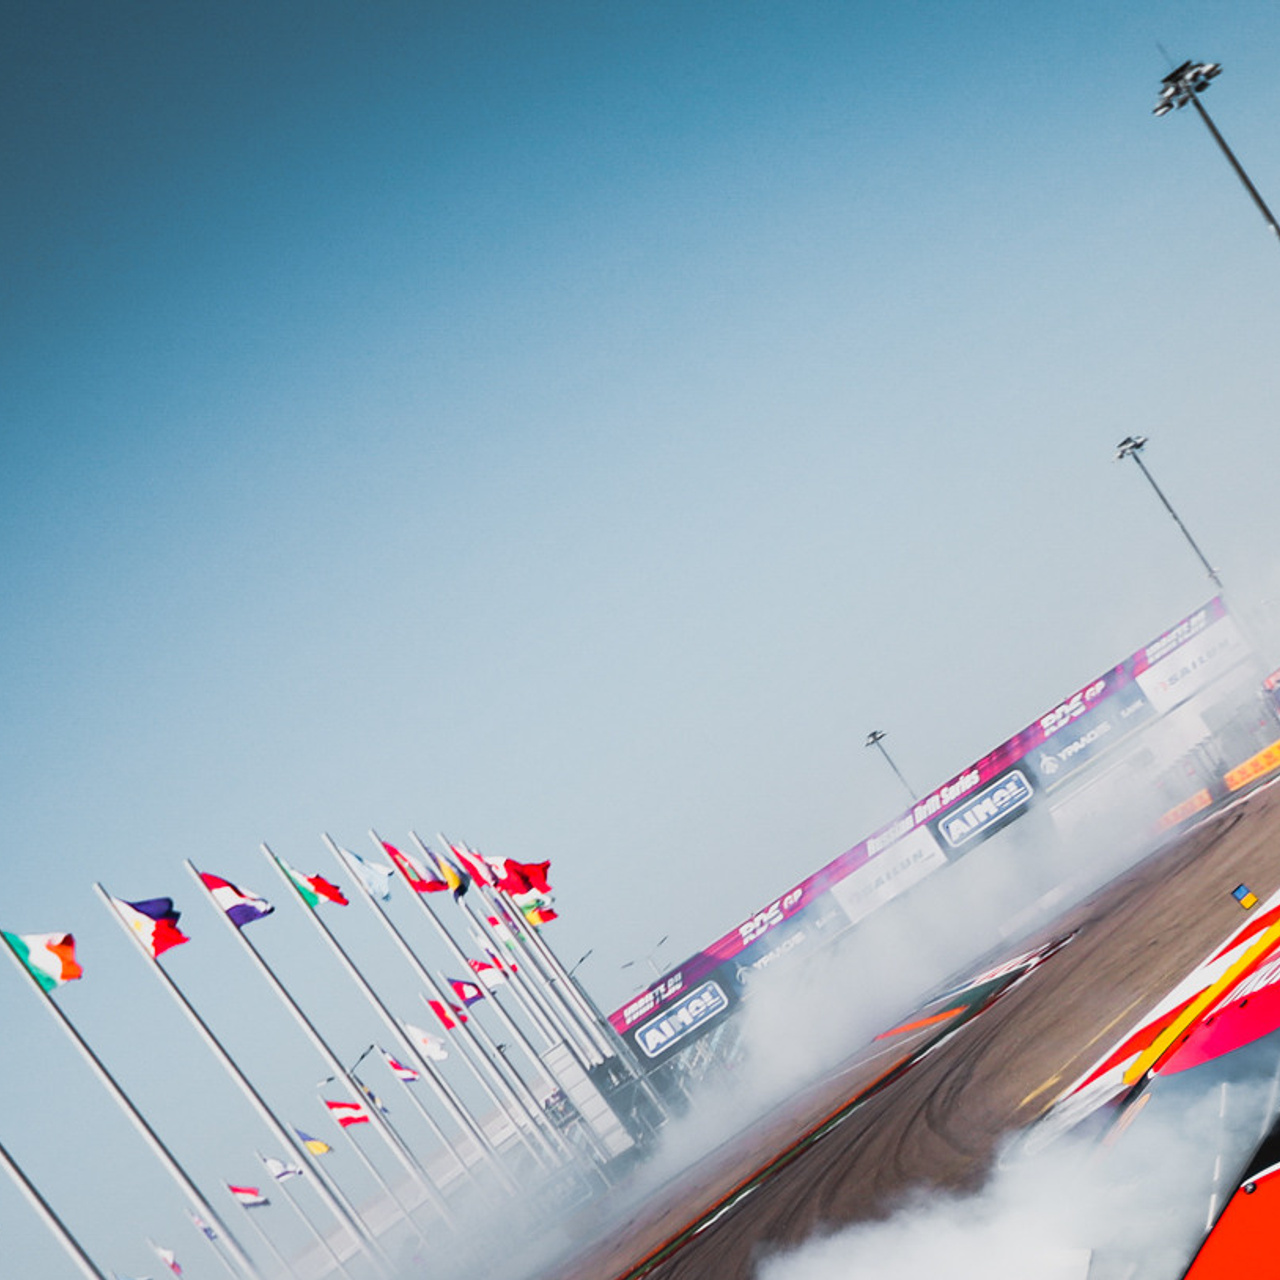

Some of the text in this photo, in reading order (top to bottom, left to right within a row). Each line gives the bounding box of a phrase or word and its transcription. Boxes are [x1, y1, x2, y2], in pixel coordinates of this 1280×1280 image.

[940, 769, 980, 806] Series
[947, 780, 1028, 842] AIMOL
[644, 987, 722, 1051] AIMOL
